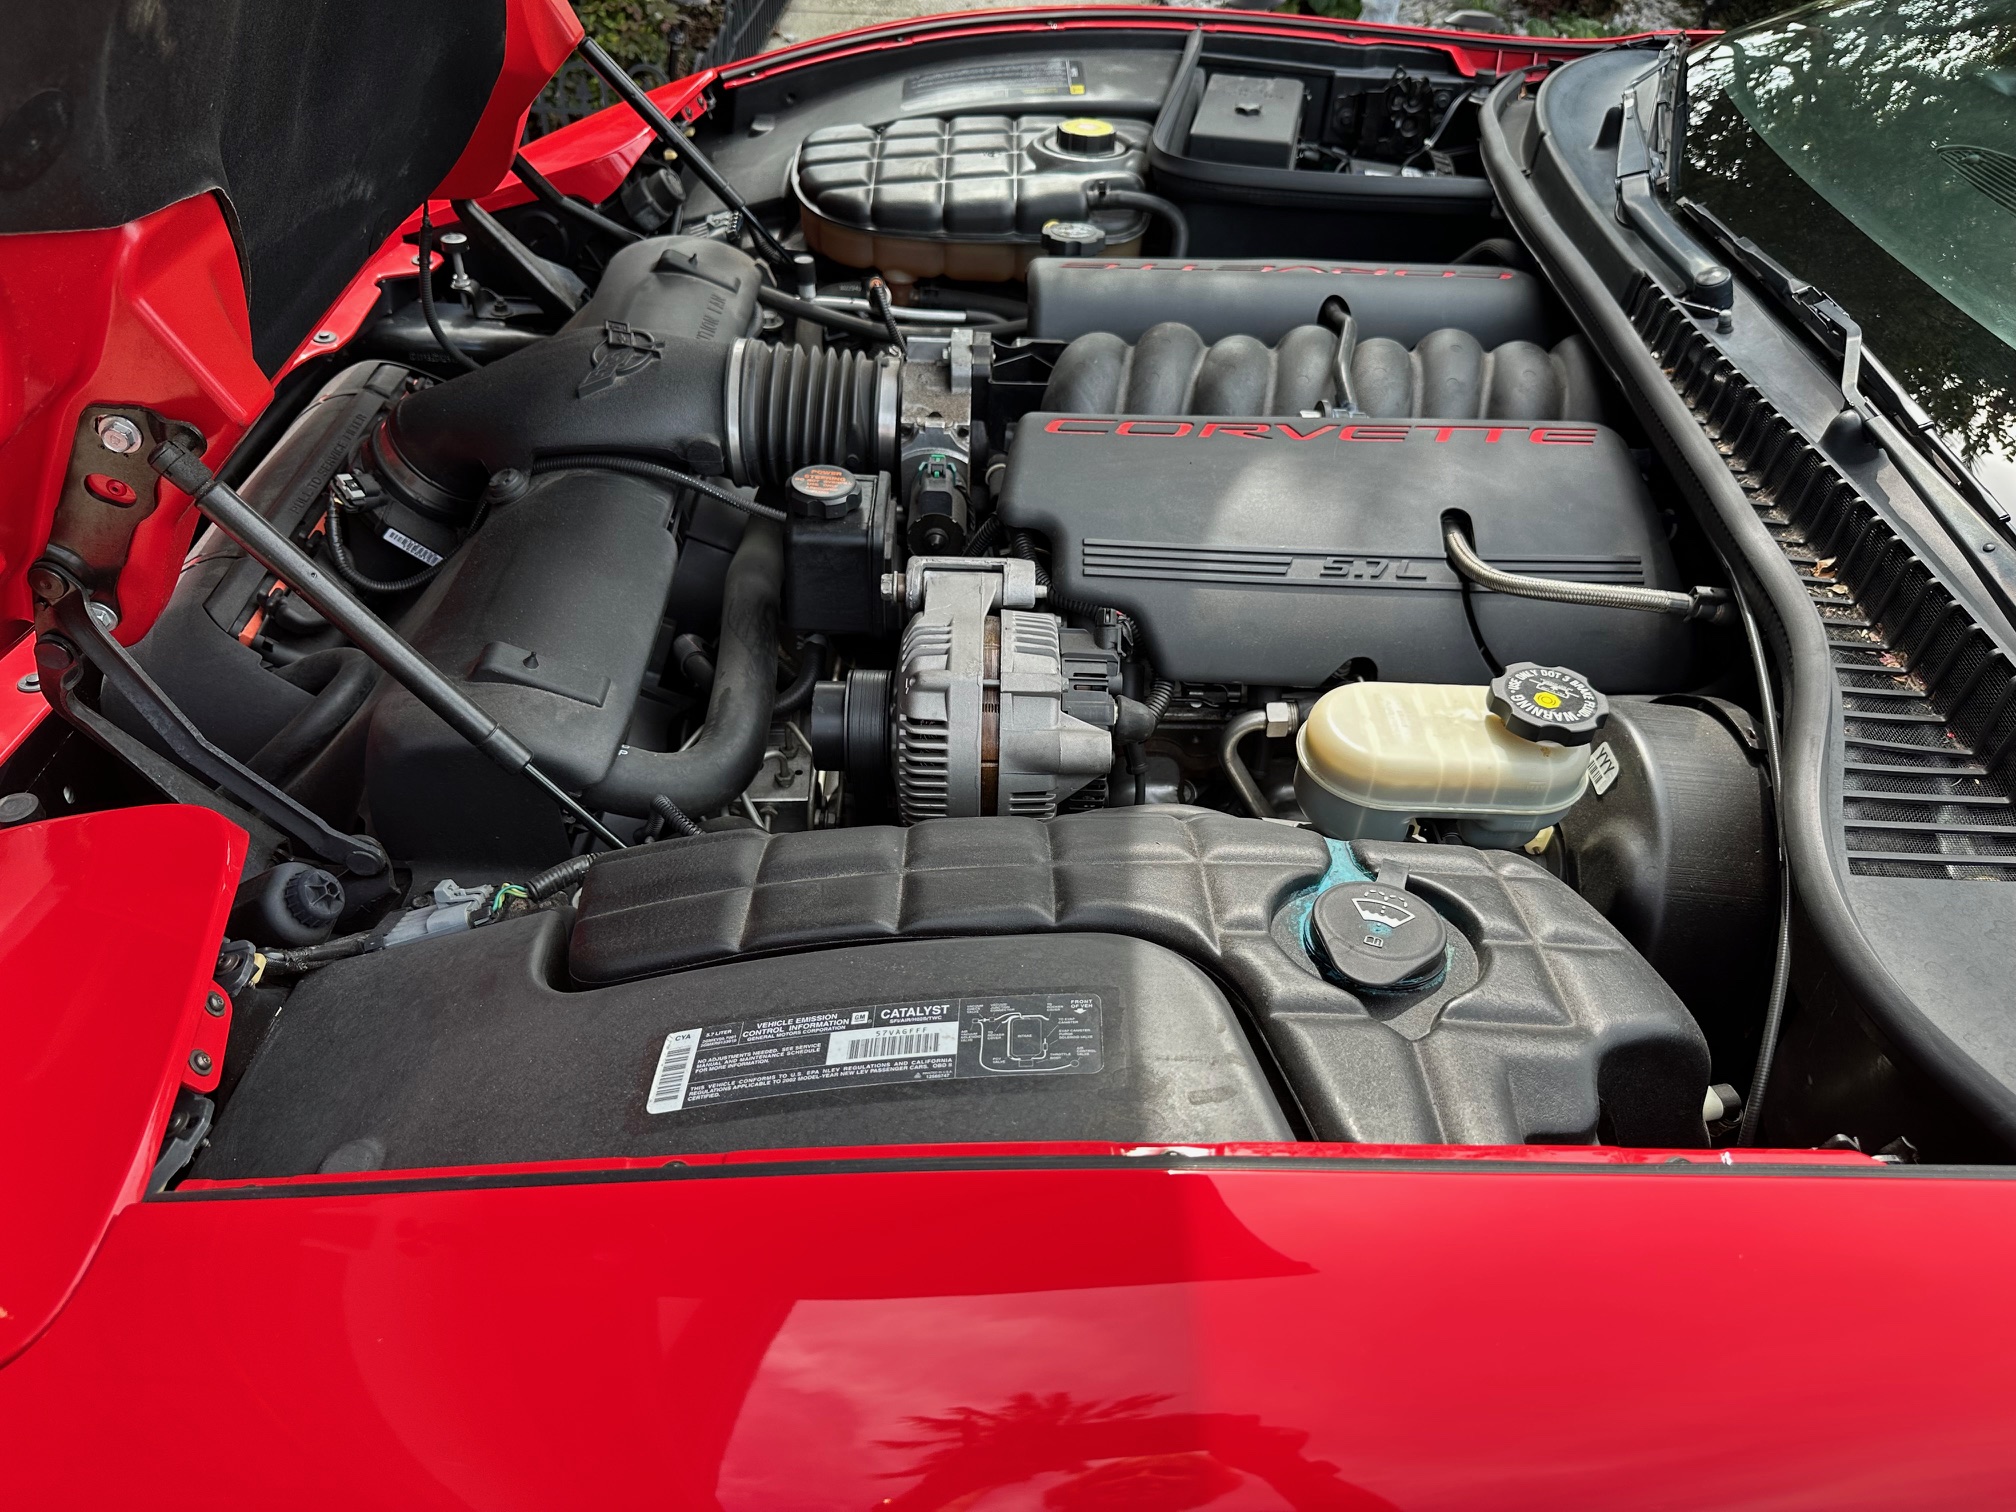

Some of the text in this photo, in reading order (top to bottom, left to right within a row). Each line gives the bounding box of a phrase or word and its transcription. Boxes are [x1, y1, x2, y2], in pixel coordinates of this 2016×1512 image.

[1044, 418, 1599, 446] CORVETTE
[290, 413, 368, 515] PULL TO SERVICE FILTER
[804, 473, 847, 482] STEERING
[1319, 556, 1428, 581] 5.7L
[1508, 676, 1522, 690] USE
[1515, 669, 1539, 680] ONLY
[1540, 669, 1562, 679] DOT
[1570, 680, 1595, 704] BRAKE
[1510, 694, 1579, 722] WARNING
[1580, 700, 1596, 718] FLUID
[1596, 747, 1615, 775] YYY
[757, 1013, 838, 1029] VEHICLE EMISSION
[881, 1004, 950, 1019] CATALYST
[675, 1033, 691, 1042] CYA
[742, 1018, 850, 1038] CONTROL INFORMATION
[746, 1034, 775, 1042] GENERAL
[776, 1030, 801, 1038] MOTORS
[802, 1025, 846, 1034] CORPORATION
[696, 1061, 721, 1069] MANUAL
[739, 1052, 784, 1062] MAINTENANCE
[786, 1048, 821, 1056] SCHEDULE
[707, 1052, 751, 1063] ADJUSTMENTS
[752, 1048, 778, 1056] NEEDED.
[795, 1042, 821, 1050] SERVICE
[708, 1080, 735, 1090] VEHICLE
[739, 1075, 776, 1084] CONFORMS
[843, 1062, 891, 1071] REGULATIONS
[911, 1057, 953, 1065] CALIFORNIA
[727, 1059, 770, 1069] INFORMATION.
[688, 1086, 731, 1097] REGULATIONS
[732, 1080, 771, 1090] APPLICABLE
[797, 1072, 839, 1082] MODEL-YEAR
[870, 1065, 908, 1074] PASSENGER
[687, 1093, 721, 1102] CERTIFIED.
